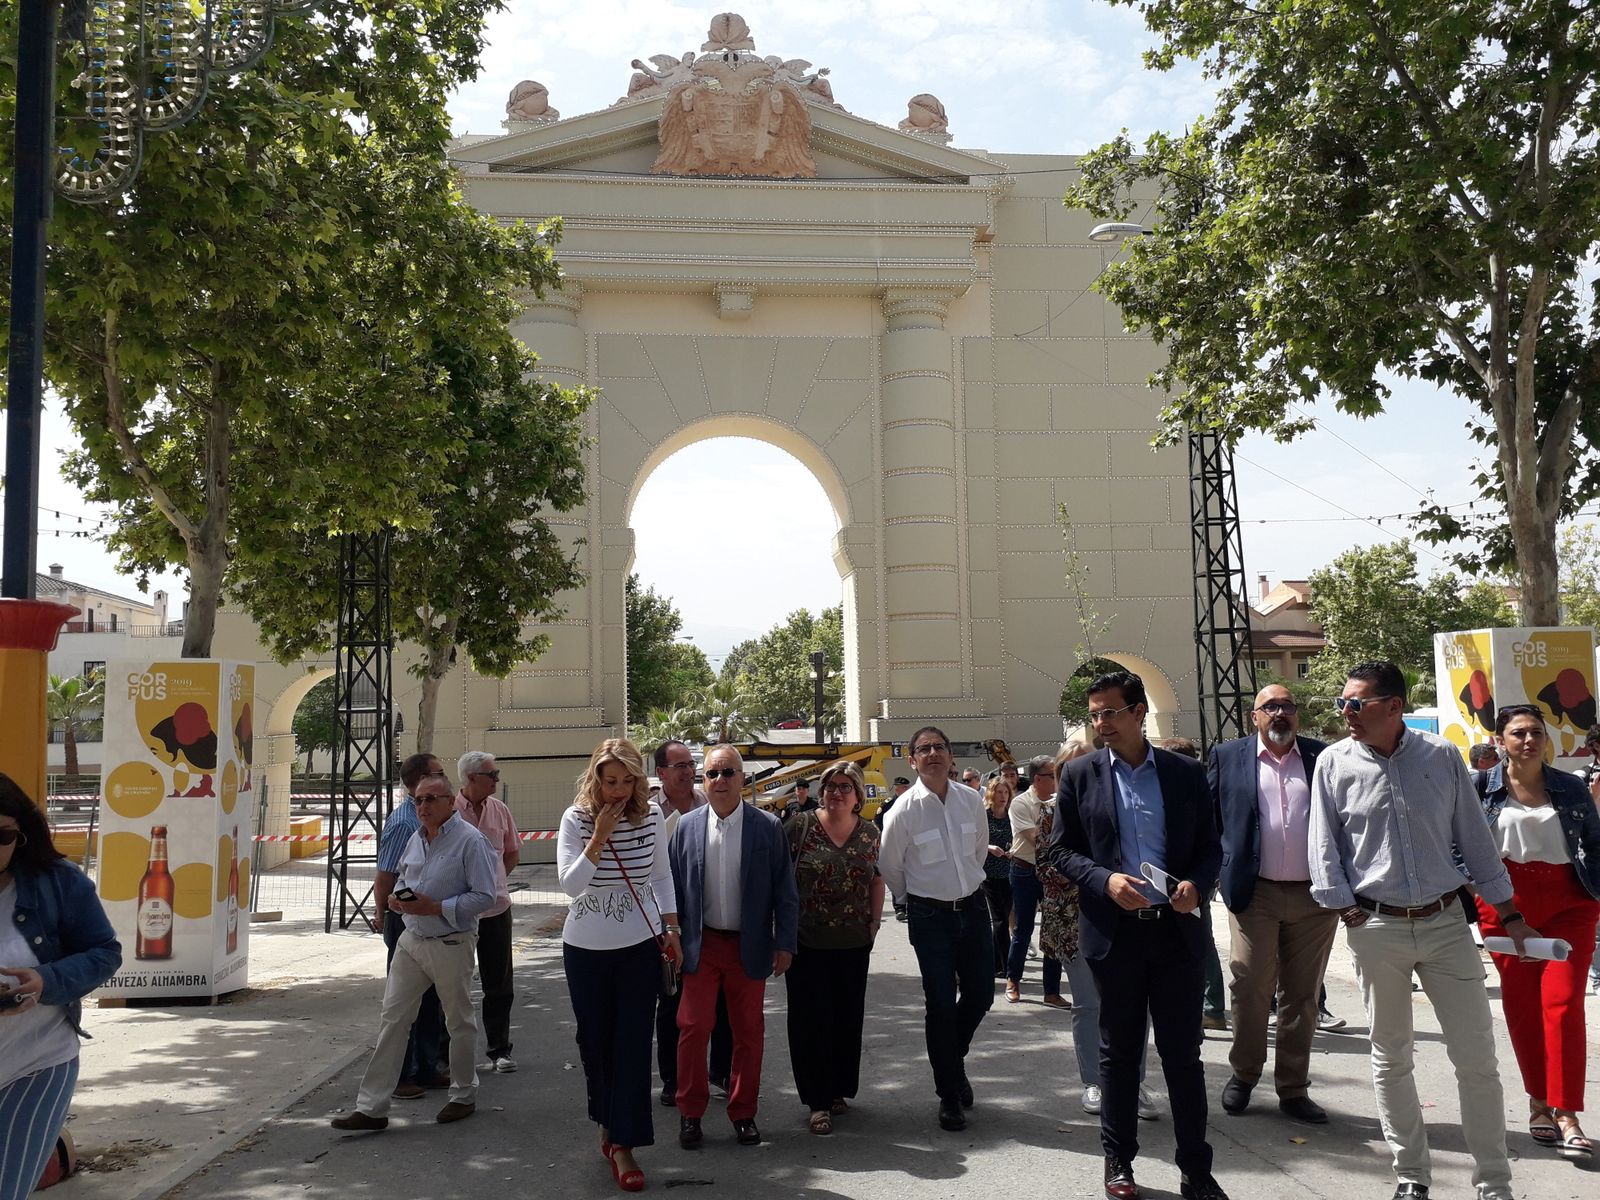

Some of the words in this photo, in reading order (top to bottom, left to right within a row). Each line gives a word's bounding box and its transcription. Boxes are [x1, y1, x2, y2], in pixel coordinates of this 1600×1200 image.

[1445, 645, 1464, 657] COR
[1512, 641, 1547, 654] COR
[1513, 654, 1548, 667] PUS
[127, 672, 167, 686] COR
[170, 679, 192, 687] 2019
[128, 686, 167, 700] PUS
[152, 975, 207, 987] ALHAMBRA
